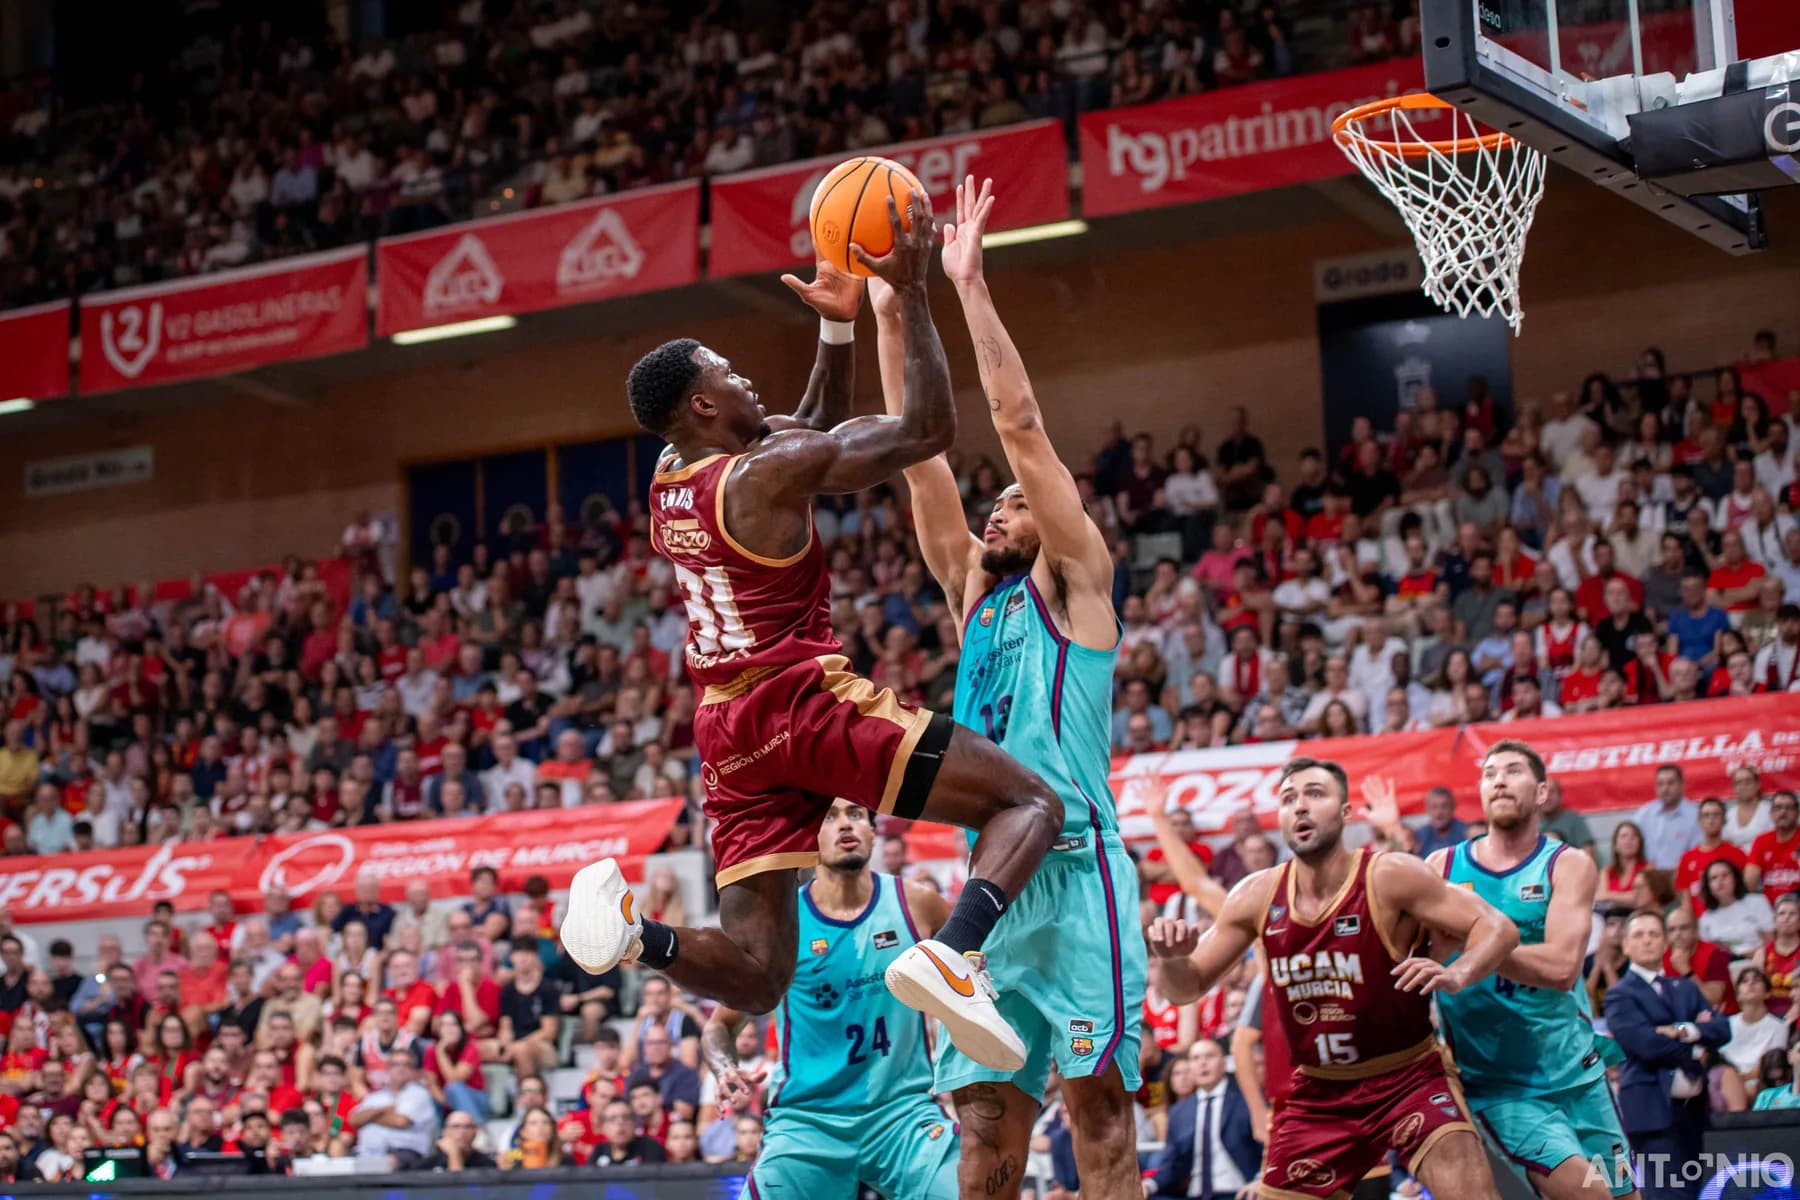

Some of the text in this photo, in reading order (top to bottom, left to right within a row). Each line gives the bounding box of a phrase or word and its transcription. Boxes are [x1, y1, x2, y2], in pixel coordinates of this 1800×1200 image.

[674, 563, 756, 655] 31
[0, 835, 214, 908] ERSUS
[1270, 950, 1365, 987] UCAM
[1286, 979, 1354, 1002] MURCIA
[846, 1015, 891, 1066] 24
[1071, 1023, 1089, 1032] acb
[1314, 1032, 1360, 1066] 15
